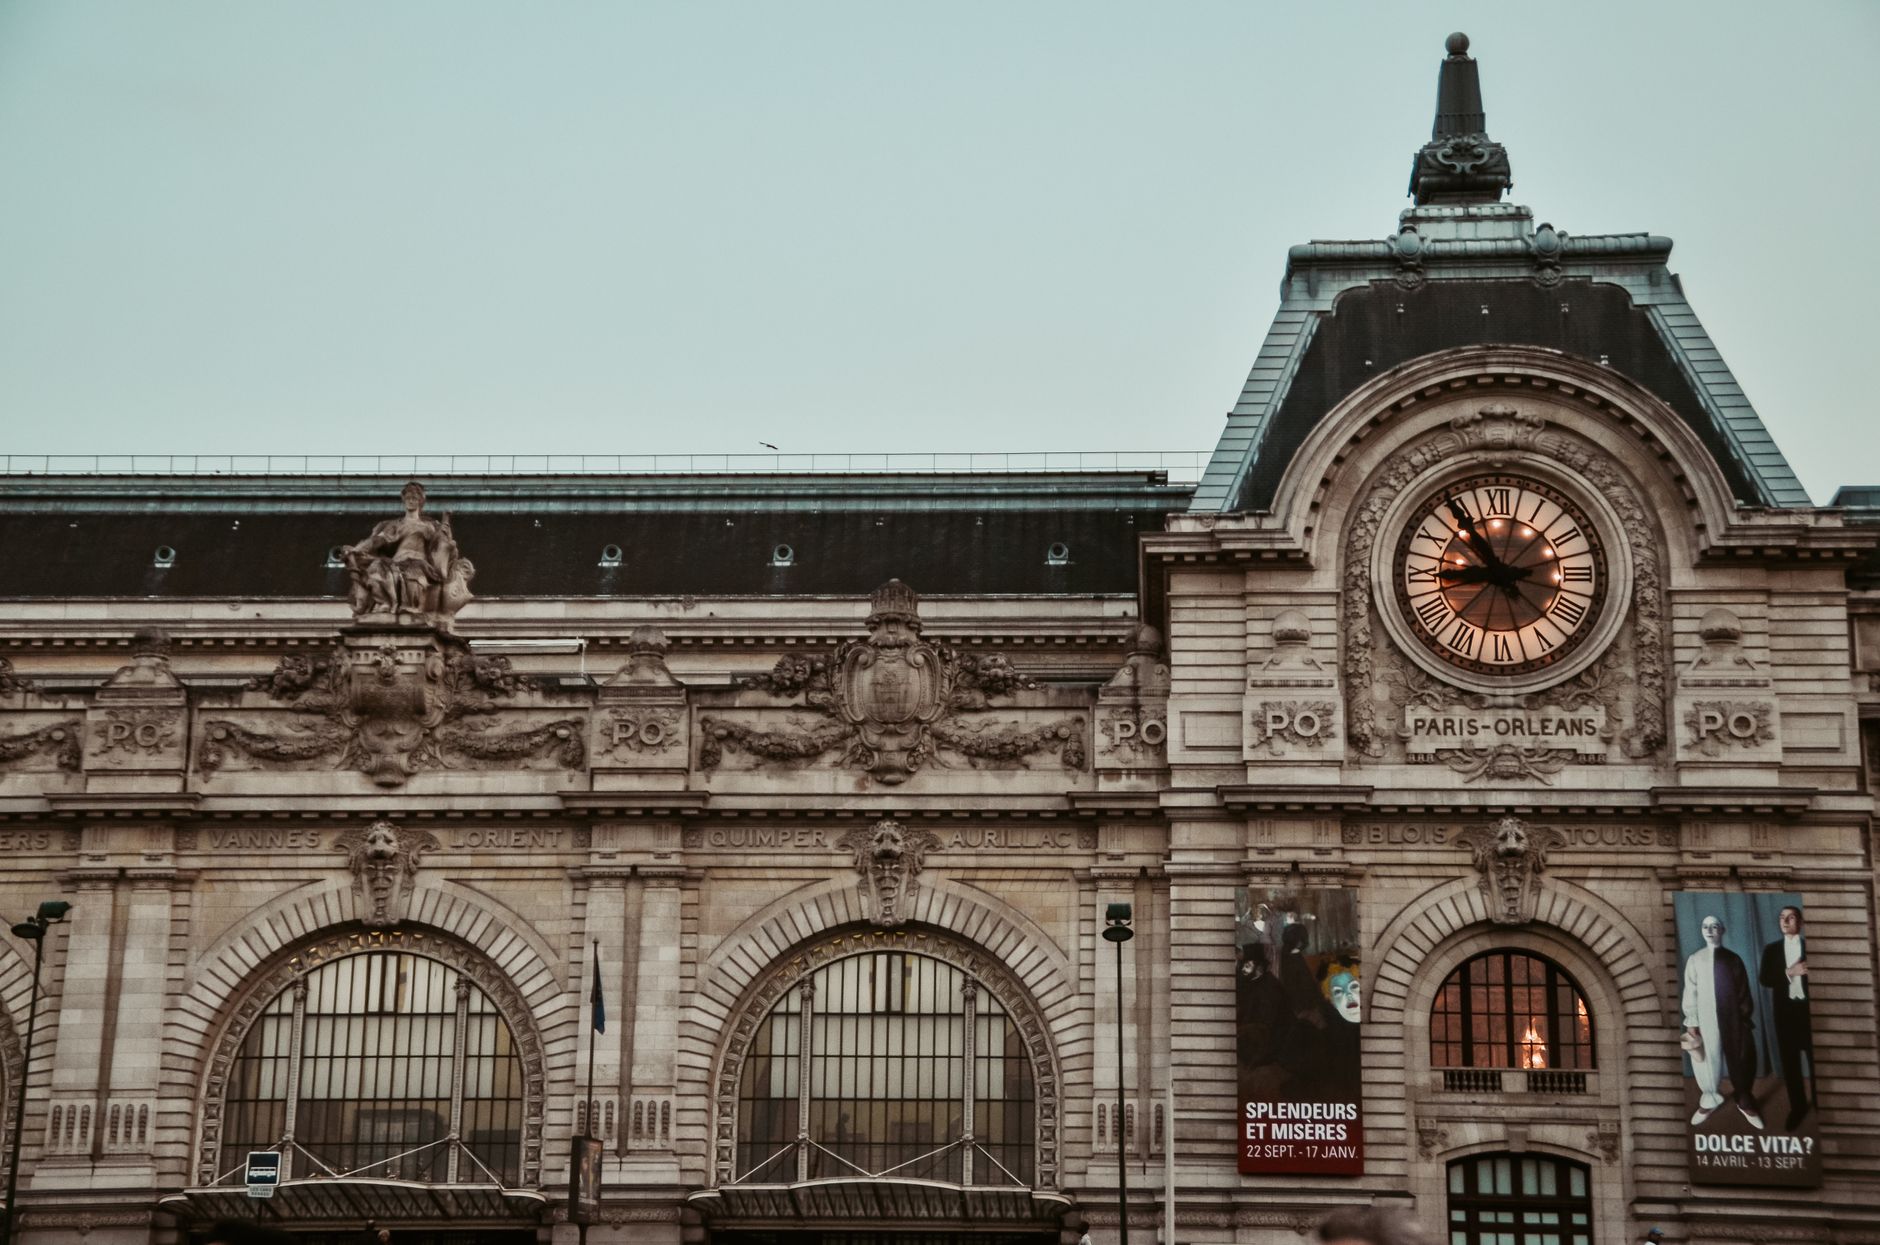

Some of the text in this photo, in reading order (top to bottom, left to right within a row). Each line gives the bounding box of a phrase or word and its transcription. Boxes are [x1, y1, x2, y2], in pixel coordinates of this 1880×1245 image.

[613, 720, 667, 746] PO
[1113, 719, 1168, 746] PO
[1266, 710, 1321, 738] PO
[1413, 718, 1597, 736] PARIS-ORLEANS
[1699, 710, 1757, 738] PO
[210, 828, 321, 849] VANNES
[449, 828, 563, 849] LORIENT
[708, 828, 829, 849] QUIMPER
[947, 828, 1073, 848] AURILLAC
[1368, 825, 1450, 844] BLOIS
[1564, 826, 1655, 846] TOURS
[1245, 1102, 1357, 1120] SPLENDEURS
[1246, 1119, 1348, 1140] ET MISÈRES
[1246, 1145, 1261, 1158] 22
[1264, 1145, 1297, 1158] SEPT.
[1306, 1146, 1318, 1158] 17
[1321, 1146, 1359, 1159] JANV.
[1694, 1133, 1814, 1155] DOLCE VITA?
[1696, 1155, 1708, 1167] 14
[1712, 1155, 1748, 1168] AVRIL
[1759, 1156, 1771, 1168] 13
